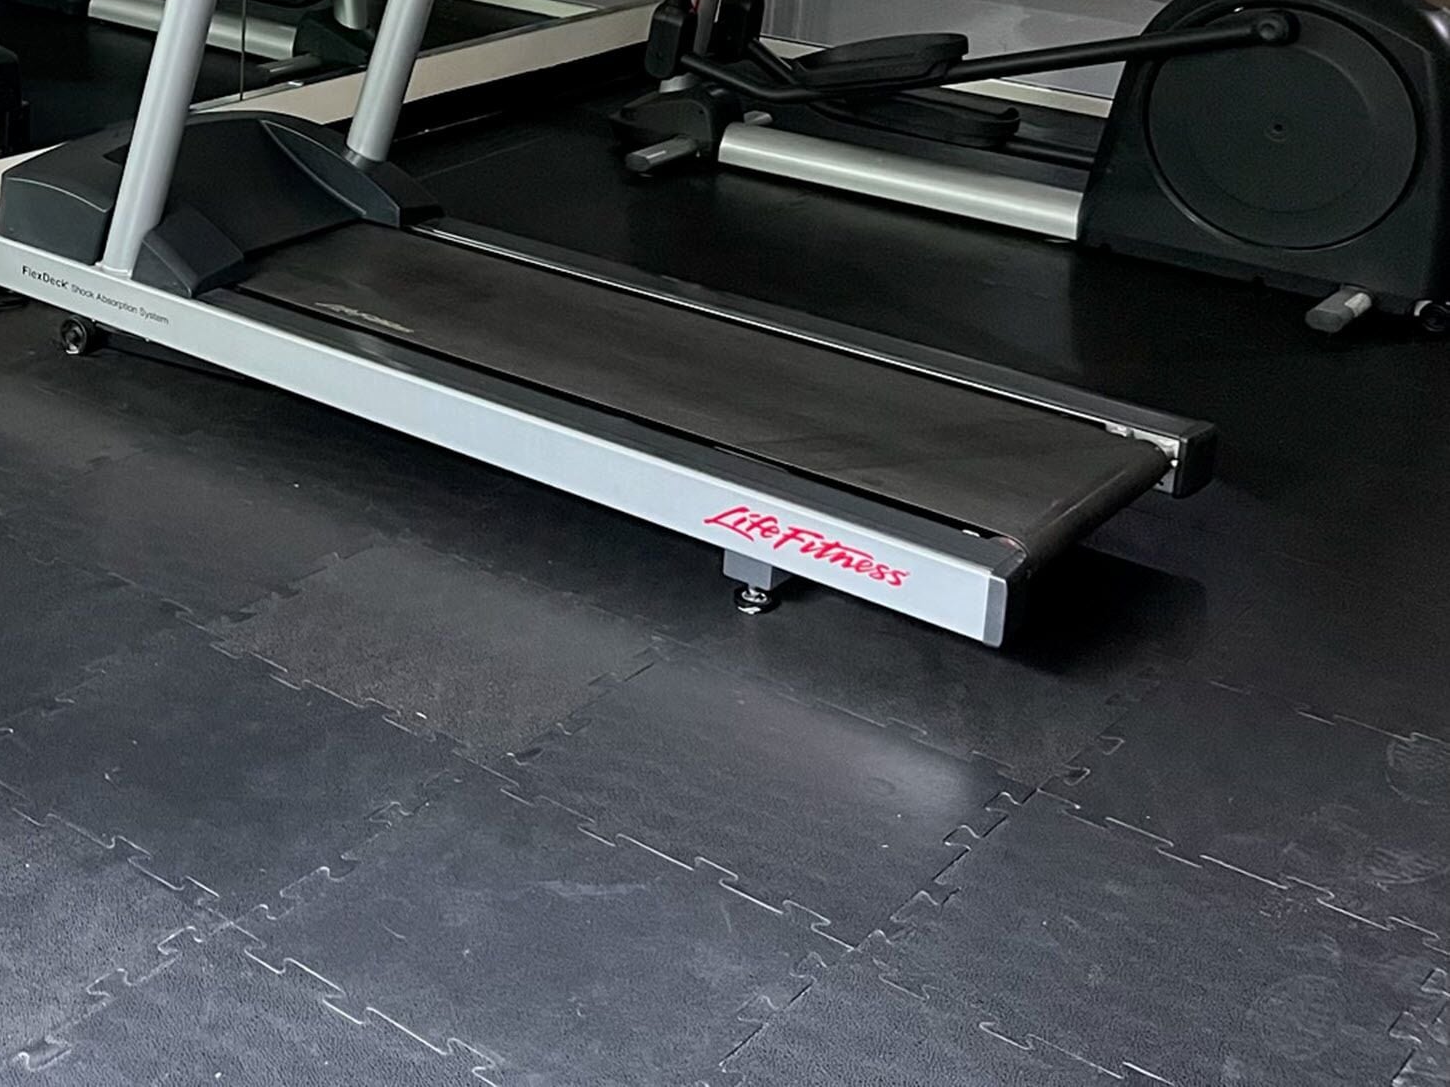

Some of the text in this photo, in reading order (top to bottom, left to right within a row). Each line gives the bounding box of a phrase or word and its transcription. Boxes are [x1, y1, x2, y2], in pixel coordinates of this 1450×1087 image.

[22, 265, 68, 289] FlexDeck
[96, 293, 138, 314] Absorption
[139, 306, 169, 325] System
[704, 506, 910, 587] Life Fitness
